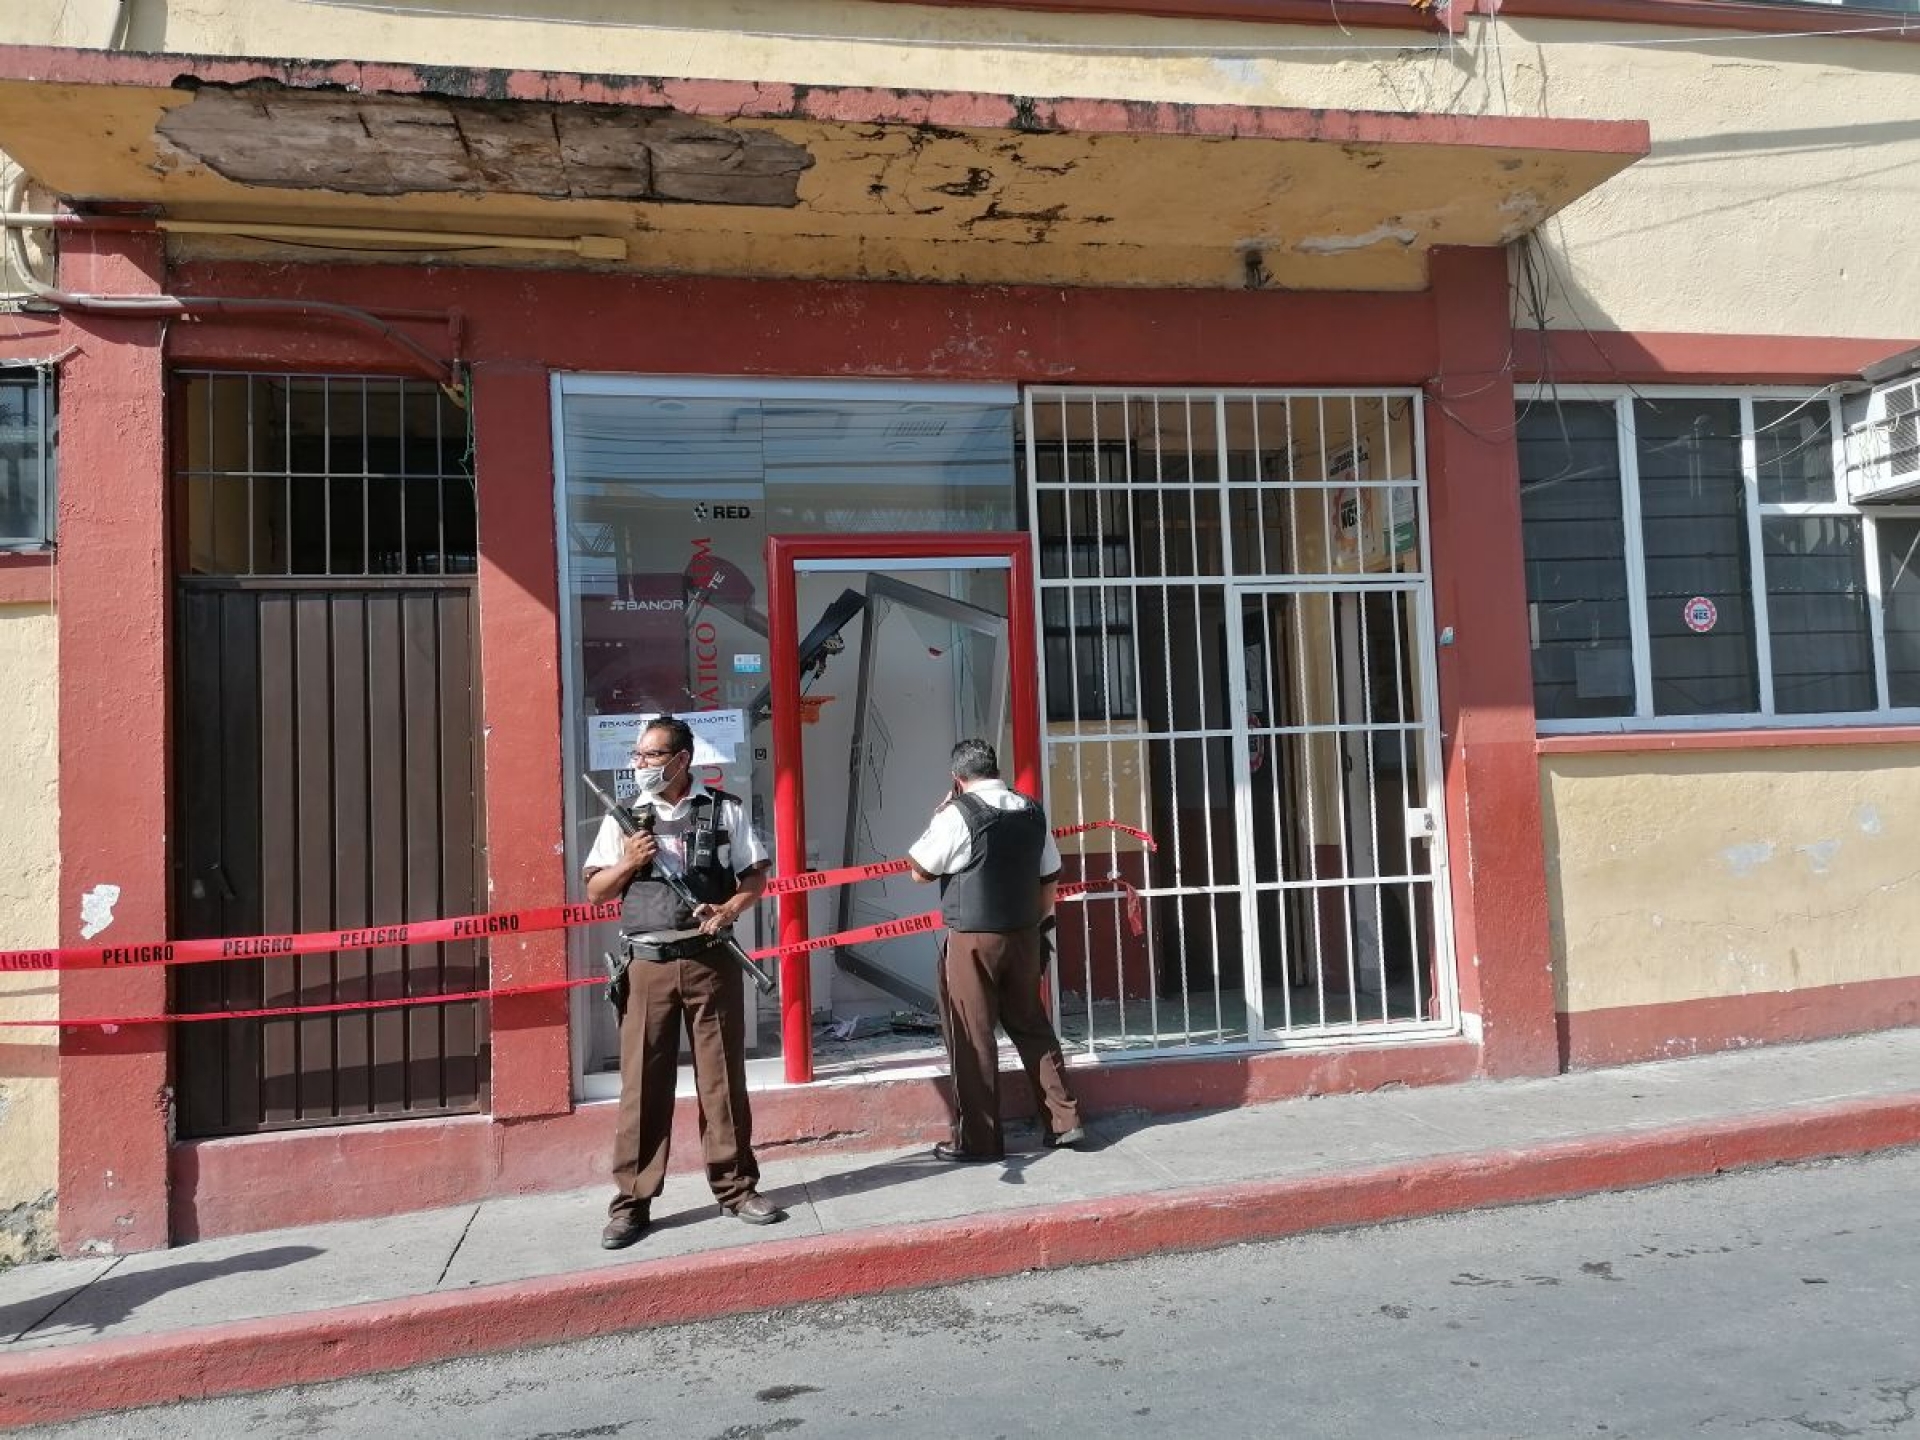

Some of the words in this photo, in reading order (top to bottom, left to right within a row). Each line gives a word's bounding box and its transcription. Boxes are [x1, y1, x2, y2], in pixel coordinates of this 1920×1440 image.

[713, 505, 751, 519] RED
[607, 719, 648, 729] BANORT
[767, 873, 827, 894] PELIGRO
[863, 859, 911, 878] PELIG
[875, 915, 932, 938] PELIGRO
[103, 944, 174, 965] PELIGRO
[223, 937, 294, 957] PELIGRO
[340, 927, 410, 948] PELIGRO
[453, 914, 520, 937] PELIGRO
